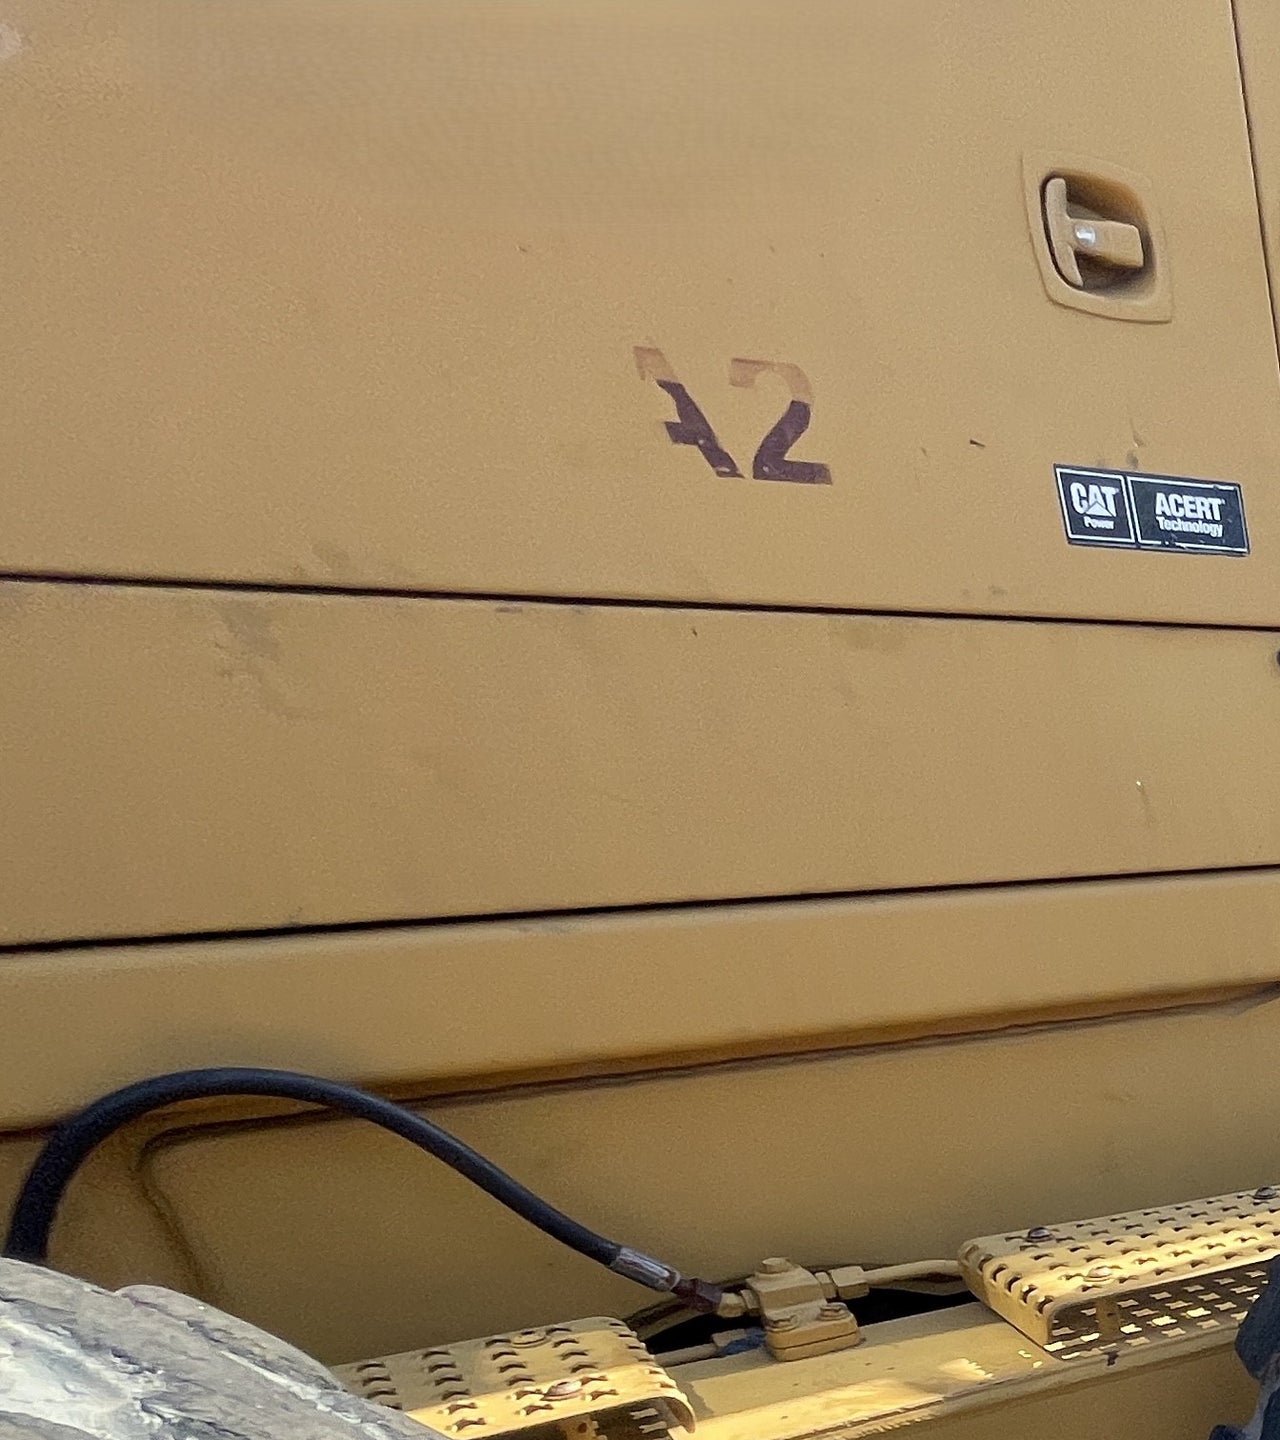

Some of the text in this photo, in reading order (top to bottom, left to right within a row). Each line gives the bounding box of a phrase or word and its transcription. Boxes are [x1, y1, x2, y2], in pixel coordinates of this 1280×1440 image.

[1070, 483, 1117, 517] CAT
[1155, 492, 1222, 521] ACERT
[1083, 516, 1115, 530] Power
[1156, 516, 1224, 538] Technology
